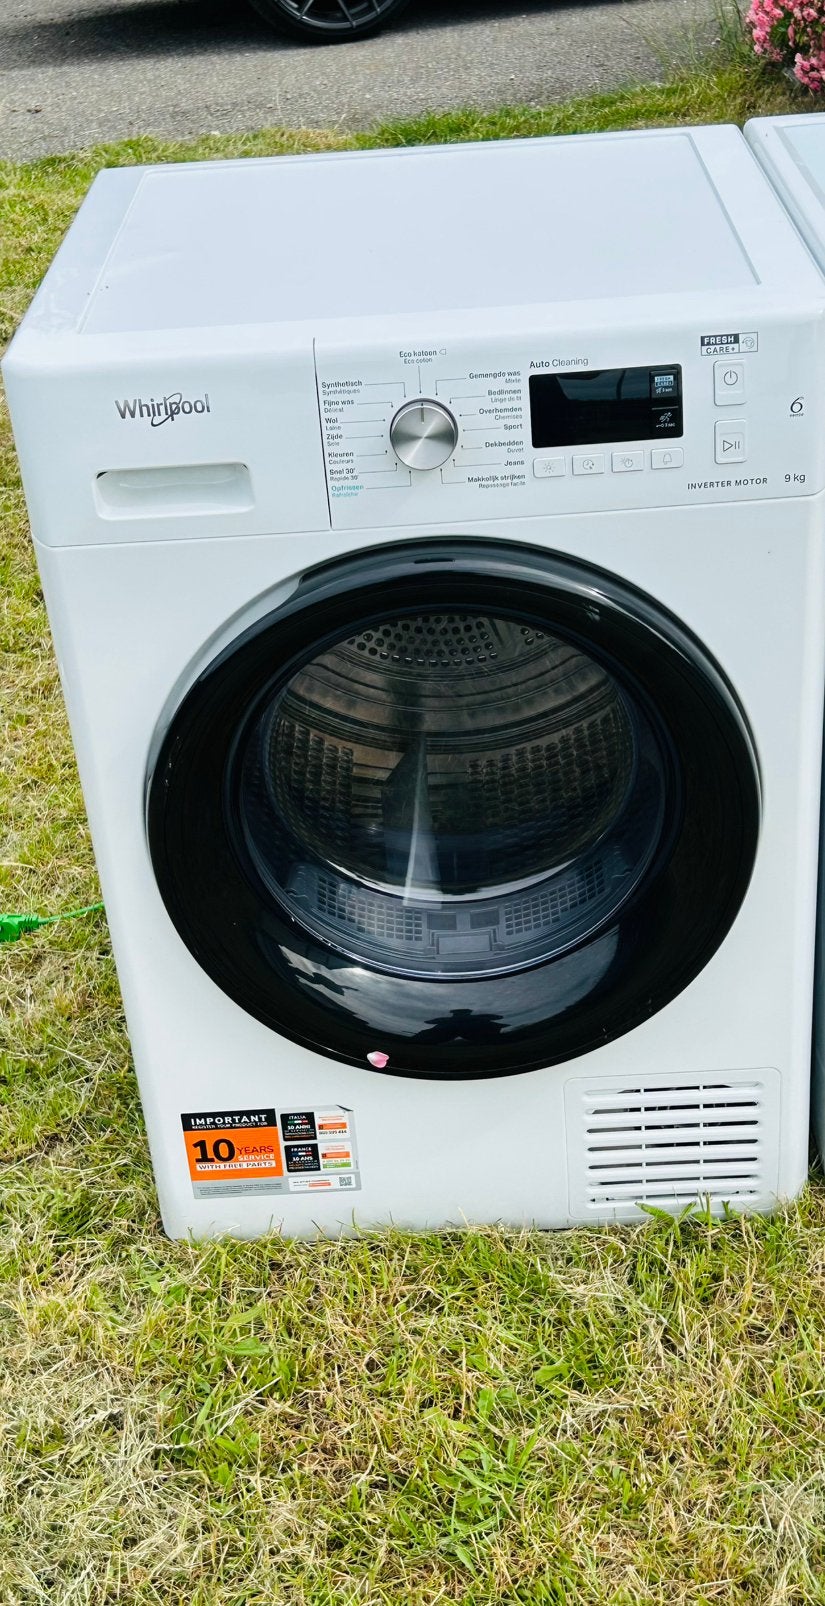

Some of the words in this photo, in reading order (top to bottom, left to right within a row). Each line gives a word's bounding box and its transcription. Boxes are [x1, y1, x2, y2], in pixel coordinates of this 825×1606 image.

[704, 335, 735, 345] FRESH
[399, 350, 412, 358] Eco
[413, 349, 437, 357] katoen
[705, 346, 736, 355] CARE+
[529, 361, 550, 369] Auto
[551, 357, 589, 367] Cleaning
[468, 371, 506, 380] Gemengde
[321, 380, 363, 389] Synthetisch
[487, 388, 522, 396] Bedlinnen
[790, 396, 804, 413] 6
[115, 392, 210, 427] Whirlpool
[479, 406, 523, 415] Overhemden
[503, 423, 523, 431] Sport
[326, 433, 343, 441] Zijde
[485, 440, 524, 448] Dekbedden
[328, 451, 354, 459] Kleuren
[467, 475, 499, 483] Makkelijk
[499, 474, 526, 482] strijken
[784, 473, 791, 483] 9
[793, 473, 806, 483] kg
[687, 480, 732, 490] INVERTER
[734, 477, 768, 487] MOTOR
[191, 1114, 268, 1126] IMPORTANT
[192, 1138, 236, 1163] 10
[236, 1145, 275, 1155] YEARS
[238, 1153, 275, 1161] SERVICE
